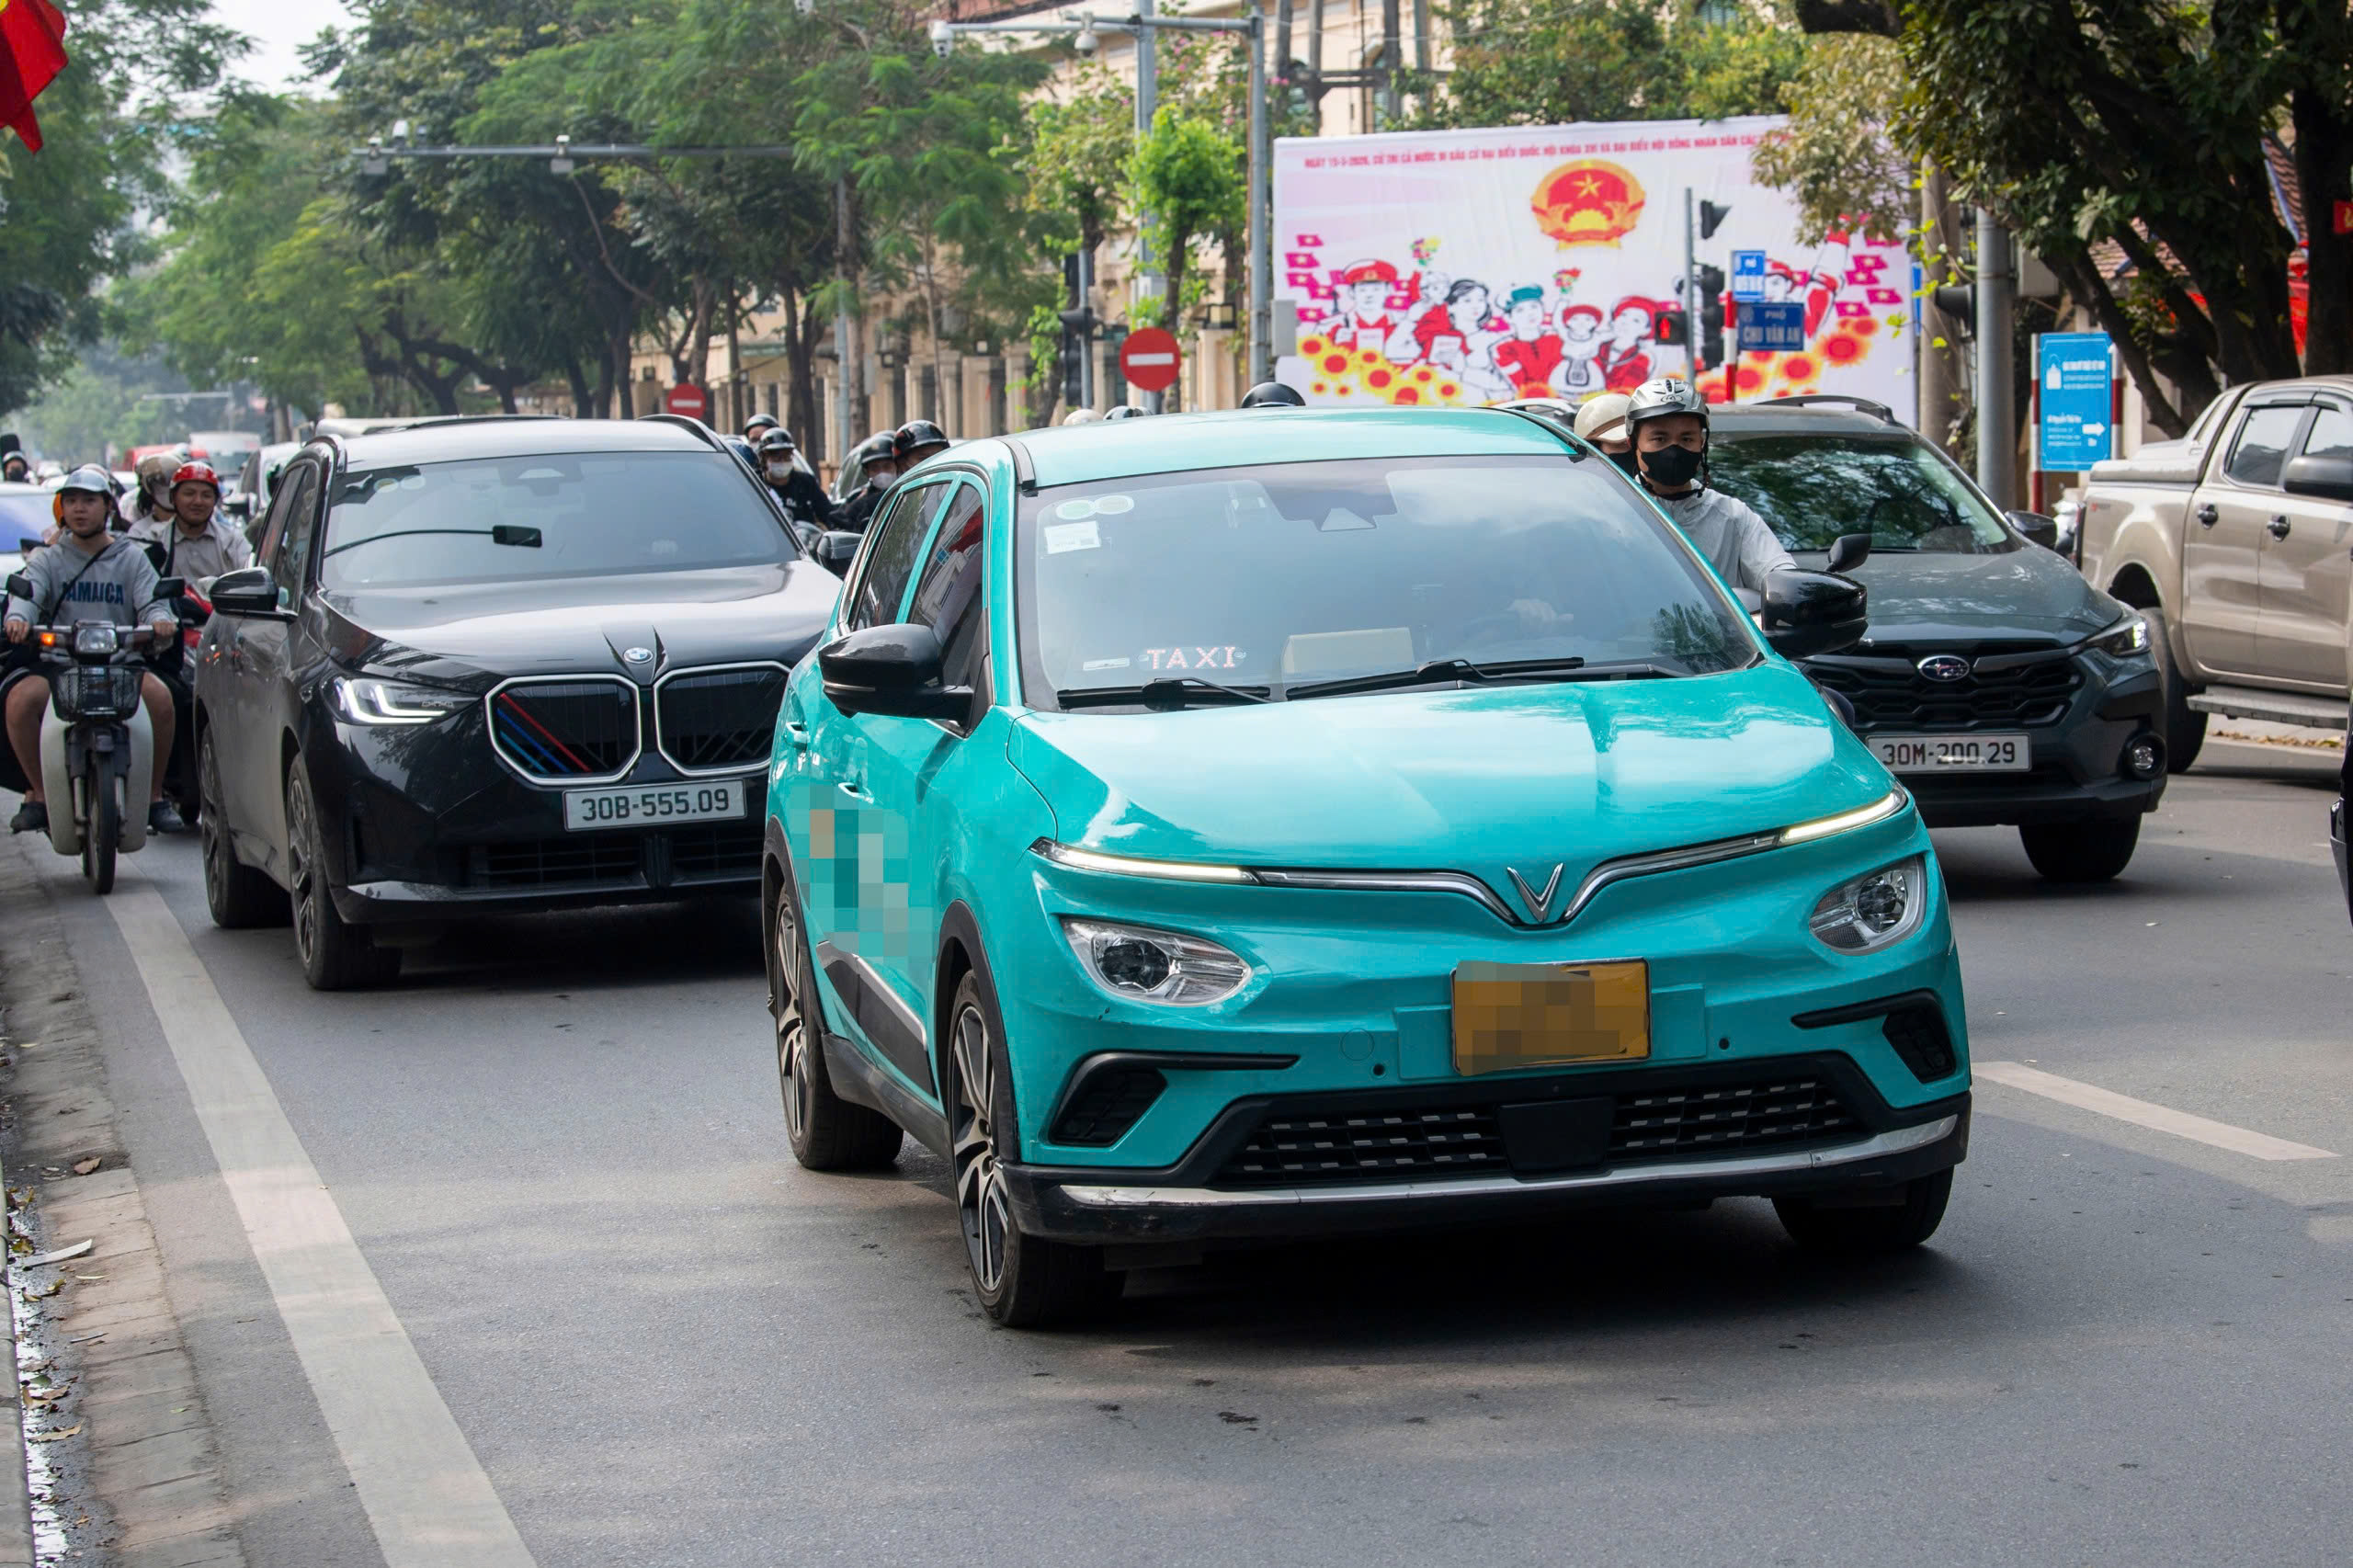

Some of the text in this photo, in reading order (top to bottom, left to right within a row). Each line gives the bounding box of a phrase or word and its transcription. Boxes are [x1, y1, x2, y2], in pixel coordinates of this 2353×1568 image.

[1743, 326, 1764, 343] CHU
[1146, 646, 1236, 670] TAXI
[1882, 741, 2016, 766] 30M-200.29
[581, 788, 730, 821] 30B-555.09
